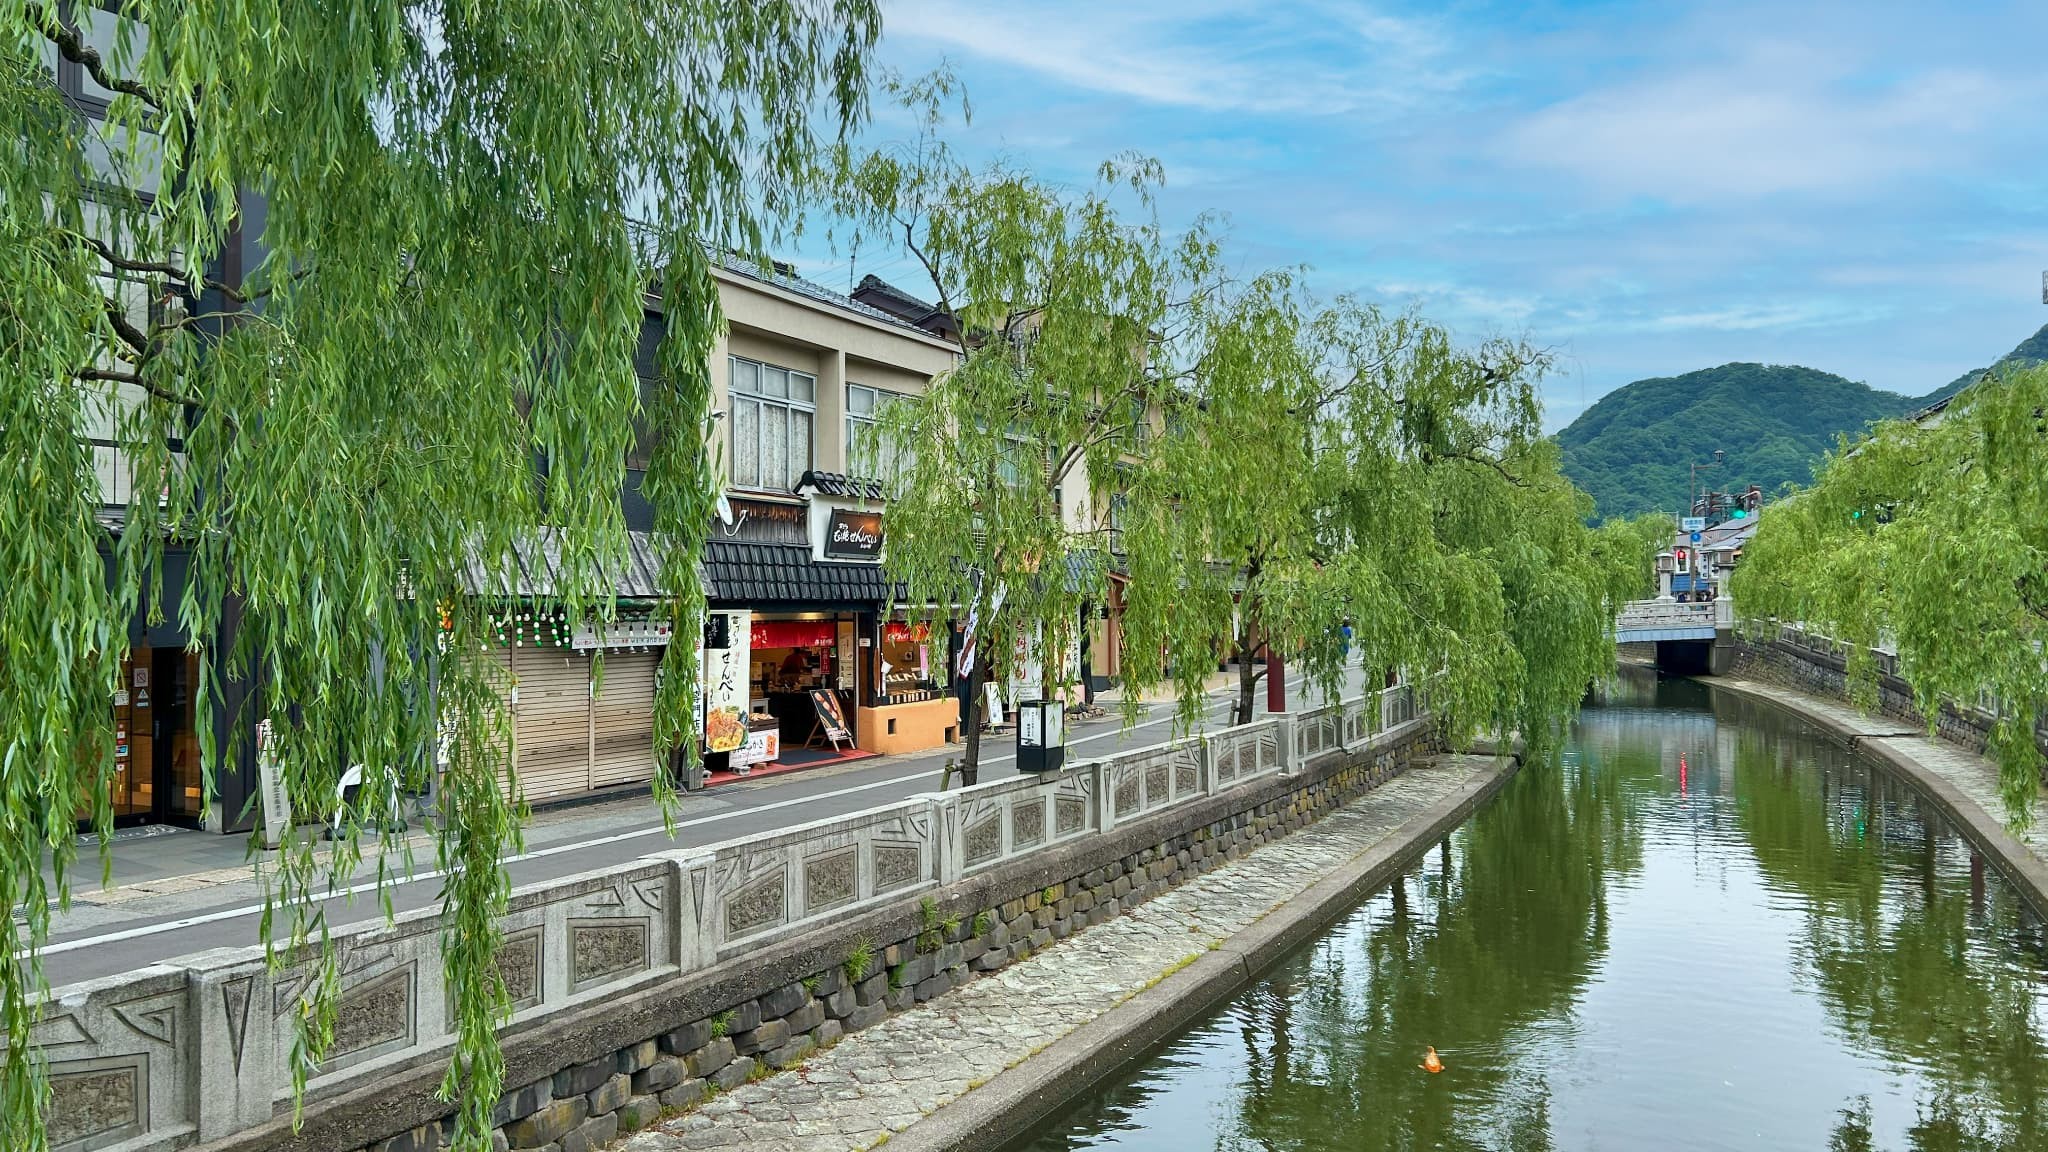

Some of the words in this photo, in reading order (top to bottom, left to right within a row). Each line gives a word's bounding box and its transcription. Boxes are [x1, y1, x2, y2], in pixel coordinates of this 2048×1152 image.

[749, 629, 768, 644] かき
[718, 651, 734, 702] せんべい
